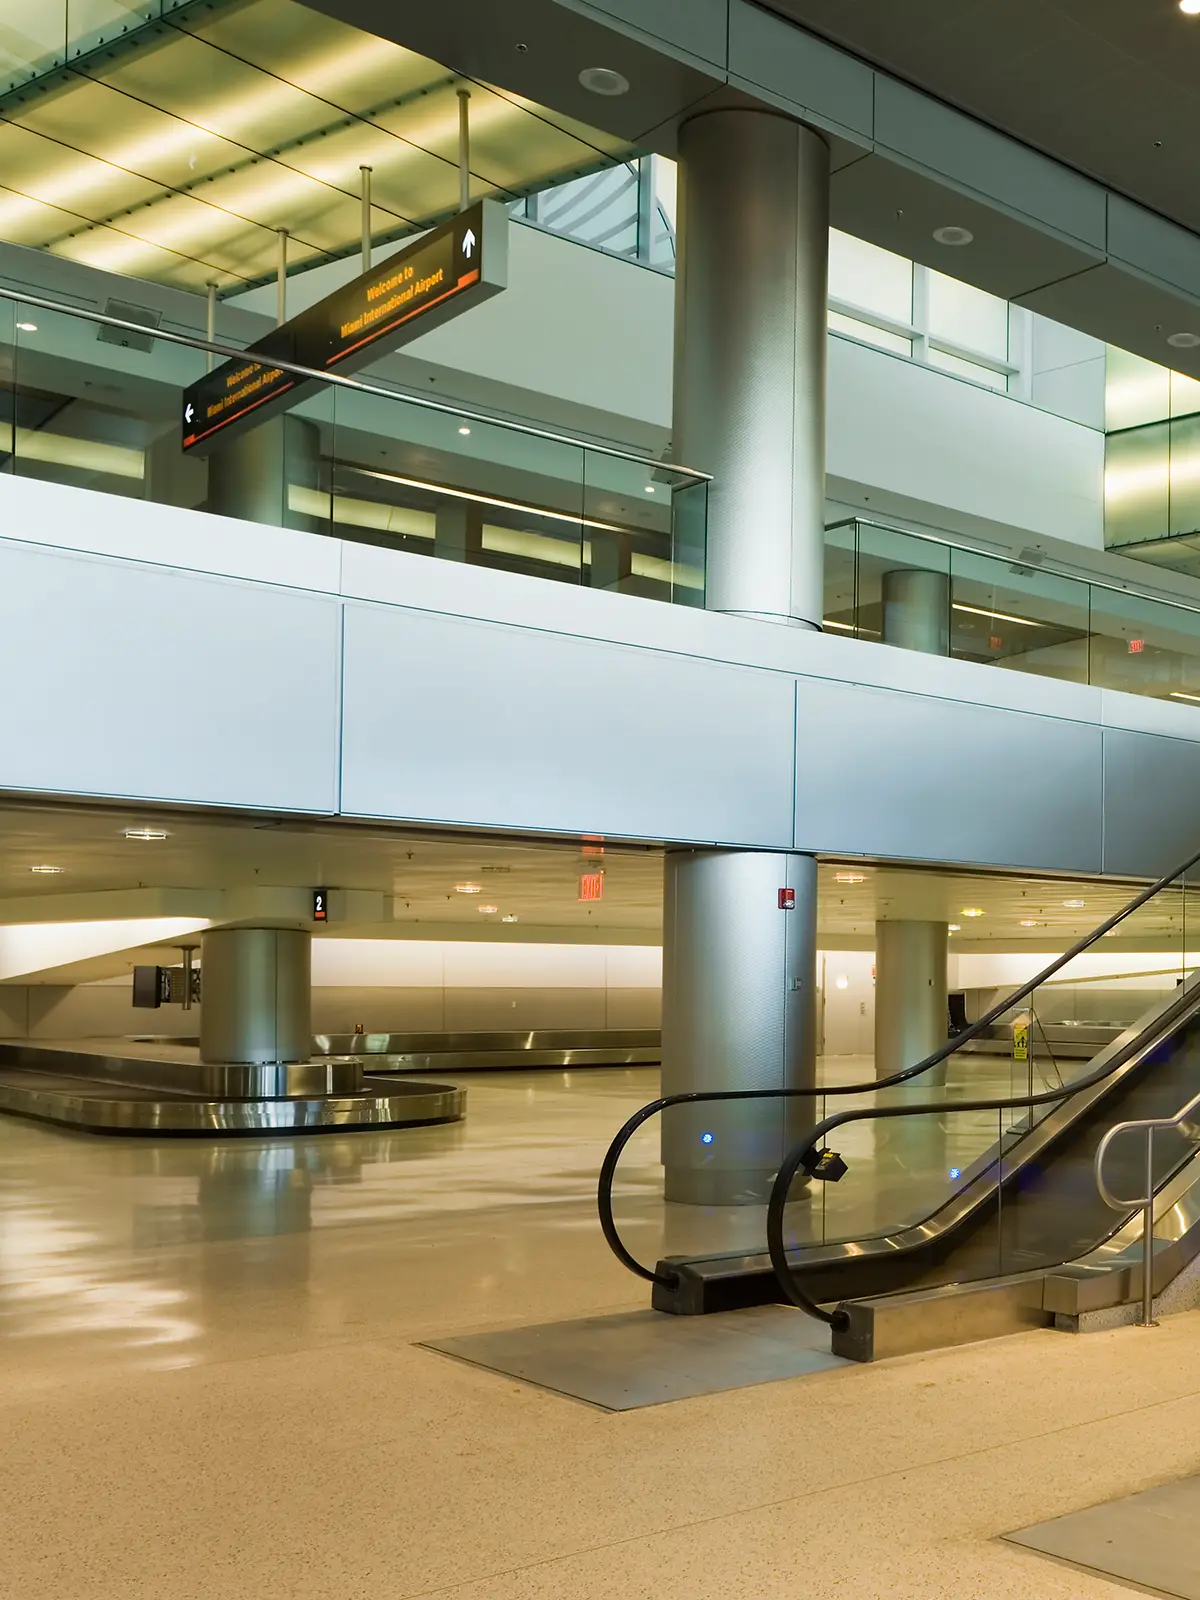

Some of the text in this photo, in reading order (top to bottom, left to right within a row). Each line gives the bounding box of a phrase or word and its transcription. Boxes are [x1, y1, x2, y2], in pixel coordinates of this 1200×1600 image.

[367, 267, 413, 301] Welcome to
[341, 268, 443, 338] Miami International Airport
[582, 874, 603, 899] EXIT
[316, 895, 322, 911] 2
